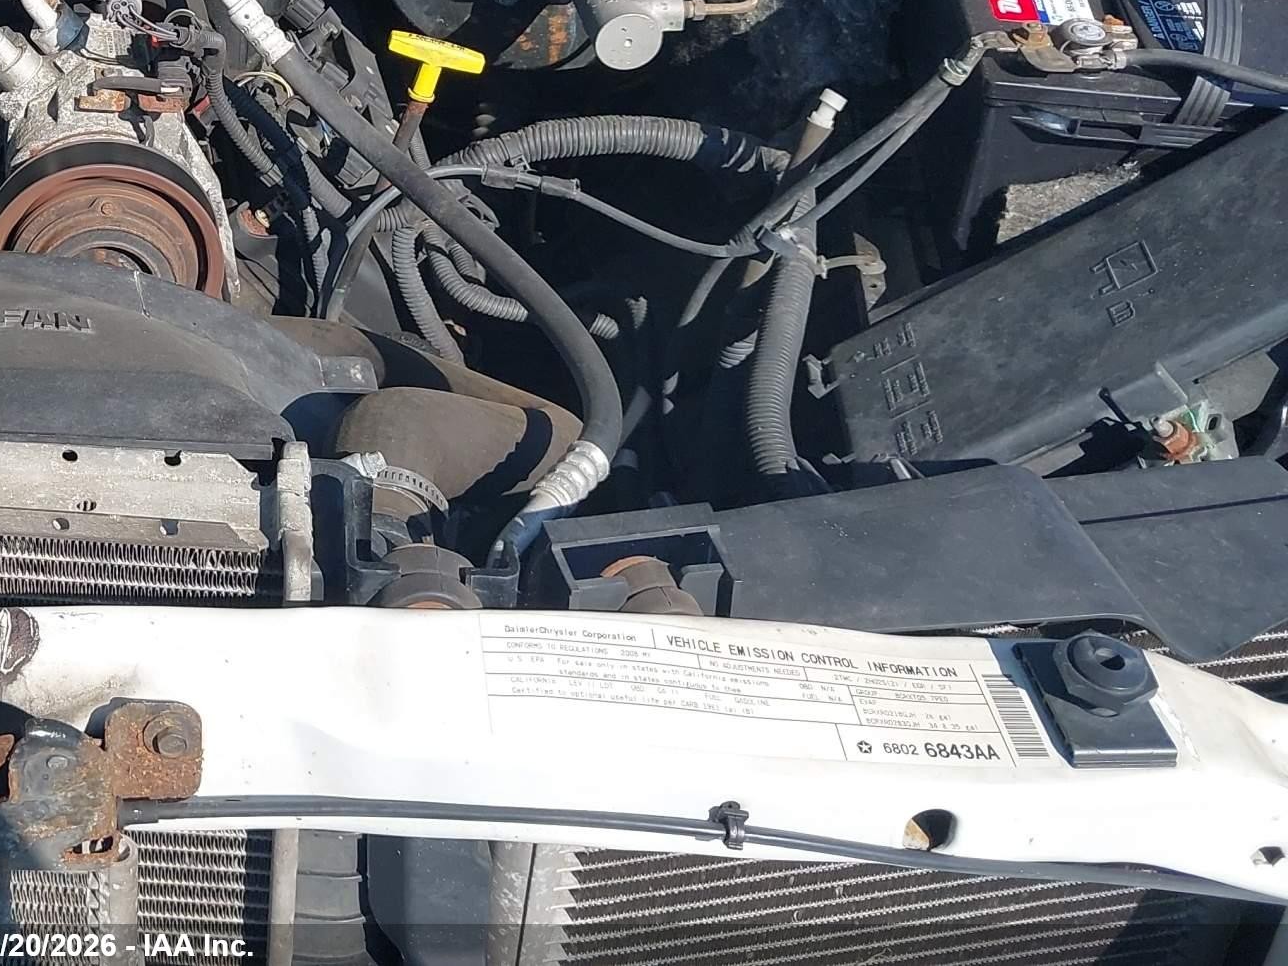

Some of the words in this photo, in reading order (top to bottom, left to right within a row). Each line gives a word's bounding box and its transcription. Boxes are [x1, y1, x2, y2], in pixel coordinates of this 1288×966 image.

[504, 625, 577, 637] DaimlerChrysler
[582, 630, 636, 643] Corporation
[559, 643, 609, 654] REGULATIONS
[666, 635, 722, 653] VEHICLE
[728, 643, 794, 662] EMISSION
[801, 652, 859, 670] CONTROL
[868, 660, 958, 677] INFORMATION
[883, 743, 919, 755] 6802
[924, 742, 1001, 760] 6843AA
